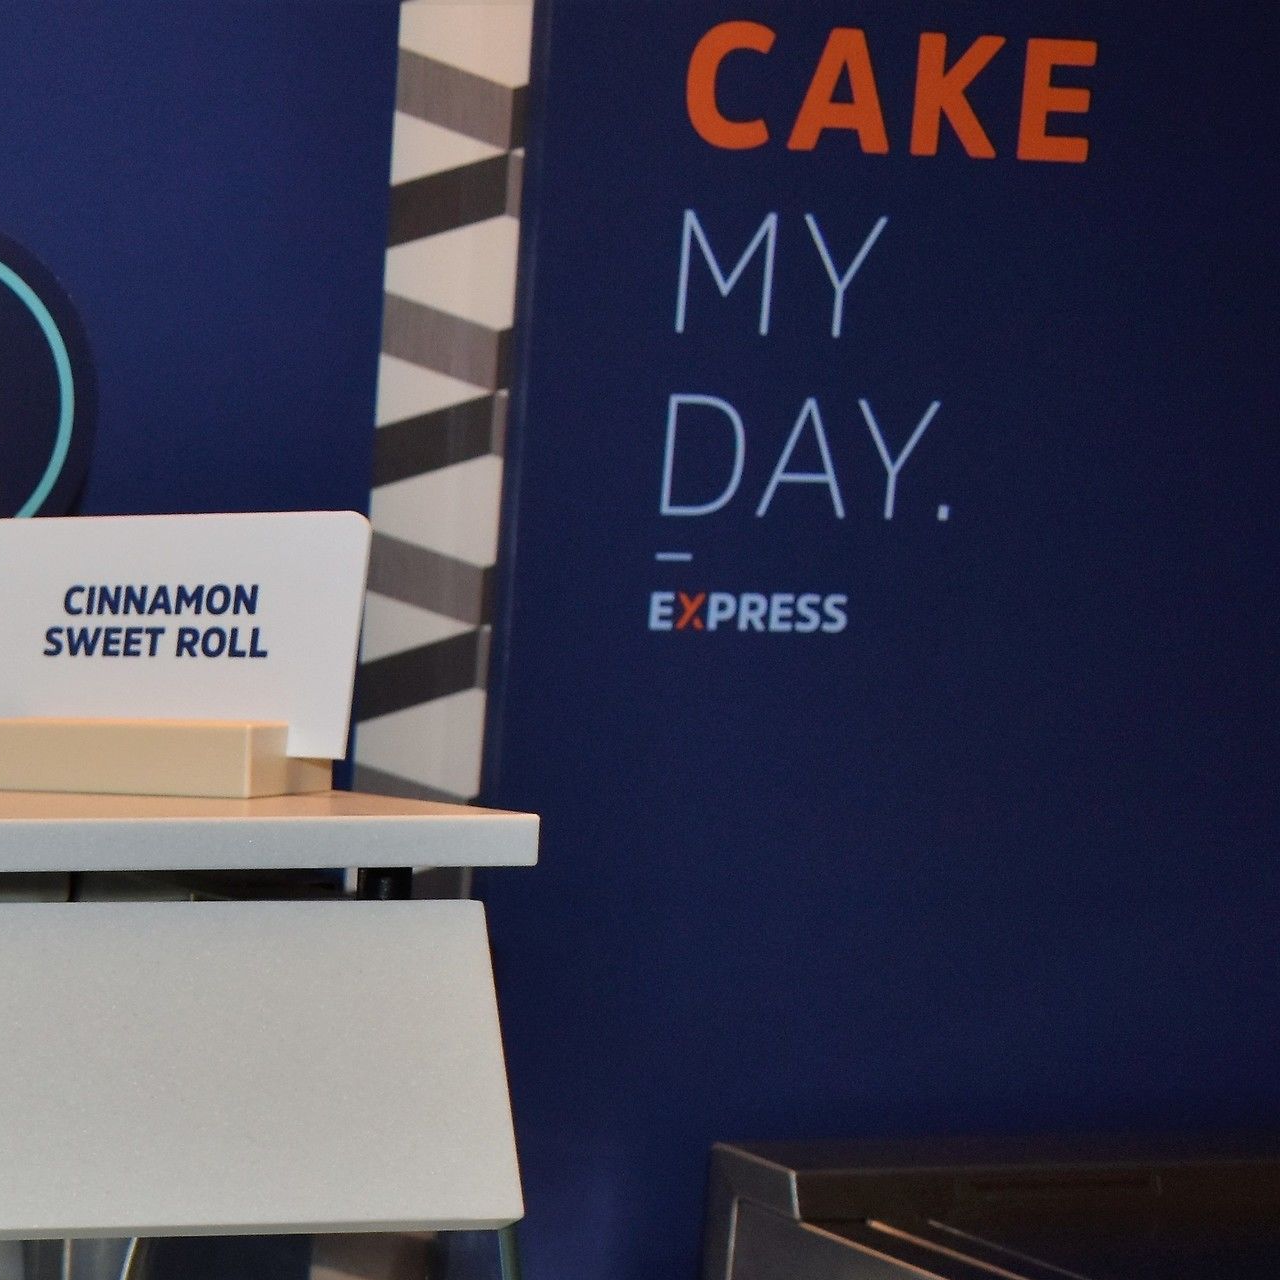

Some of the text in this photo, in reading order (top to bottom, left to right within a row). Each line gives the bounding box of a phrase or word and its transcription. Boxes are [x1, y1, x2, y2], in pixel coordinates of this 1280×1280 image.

[686, 21, 1097, 164] CAKE
[676, 209, 888, 338] MY
[660, 394, 950, 521] DAY.
[64, 584, 259, 615] CINNAMON
[648, 591, 848, 632] EXPRESS
[43, 626, 268, 658] SWEET ROLL
